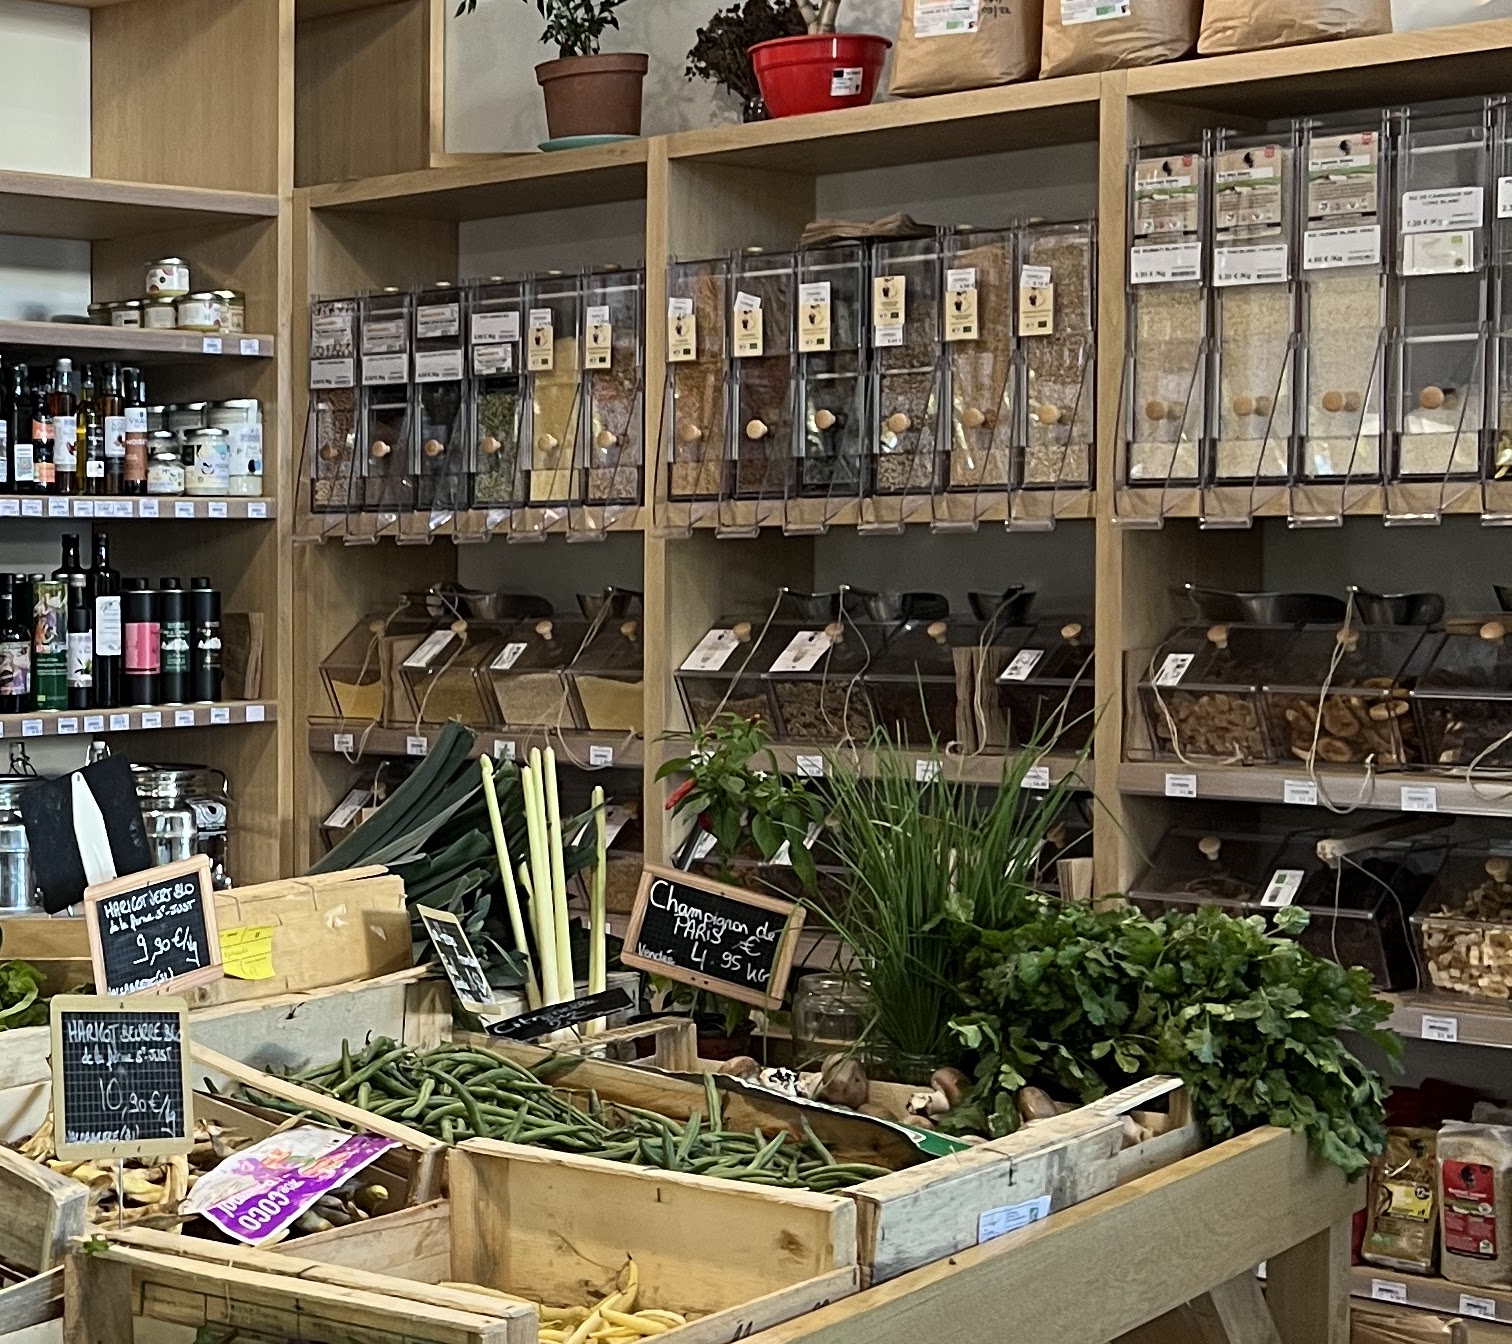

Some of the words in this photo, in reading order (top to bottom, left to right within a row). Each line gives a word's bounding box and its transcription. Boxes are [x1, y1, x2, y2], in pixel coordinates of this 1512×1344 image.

[103, 890, 149, 919] HARICOT
[649, 879, 749, 937] Champignon
[755, 921, 778, 942] de
[673, 912, 723, 945] PARIS
[66, 1020, 117, 1050] HARICOT
[120, 1022, 162, 1044] BEURRE
[238, 1189, 291, 1232] COCO
